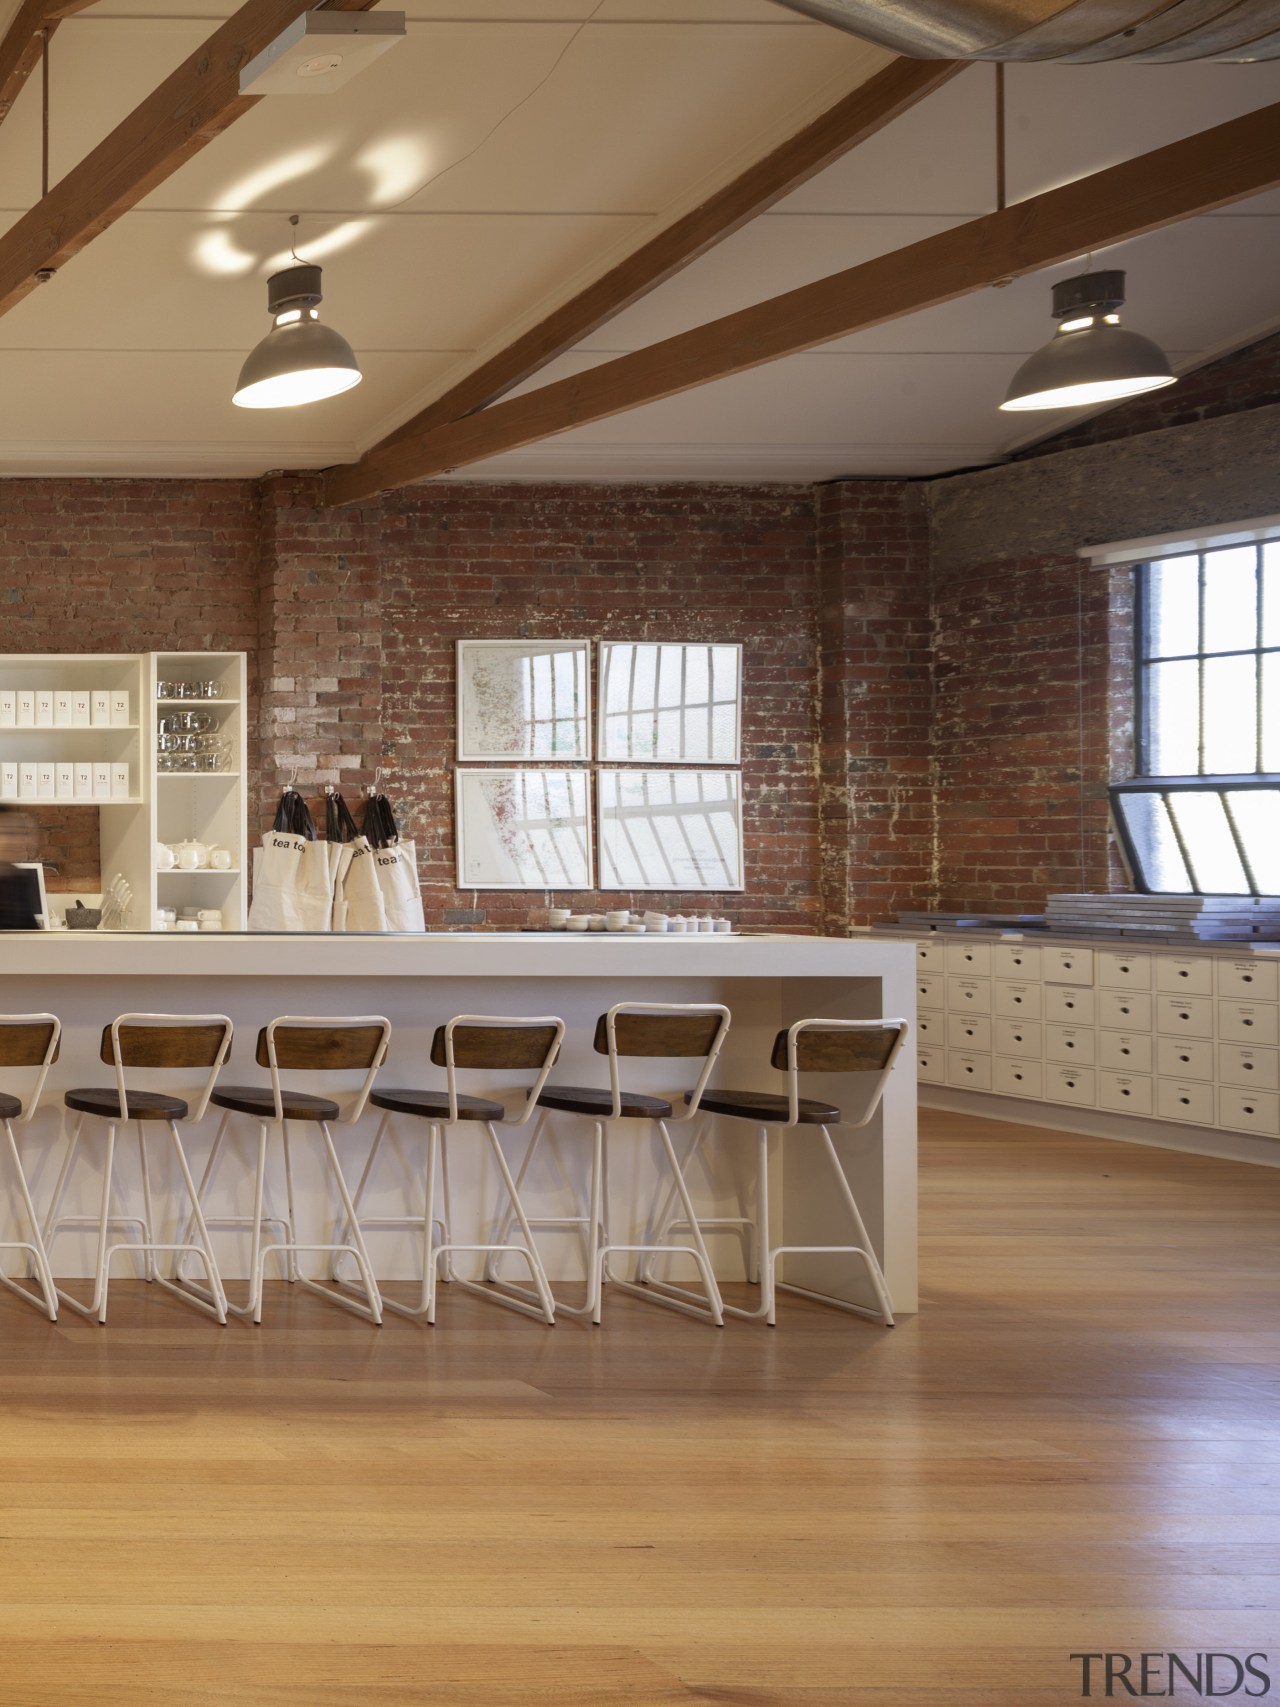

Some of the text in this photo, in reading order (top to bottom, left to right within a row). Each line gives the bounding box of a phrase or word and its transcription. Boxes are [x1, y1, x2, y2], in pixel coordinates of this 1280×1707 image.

[273, 838, 290, 848] tea
[353, 848, 364, 857] ea
[378, 856, 397, 866] tea
